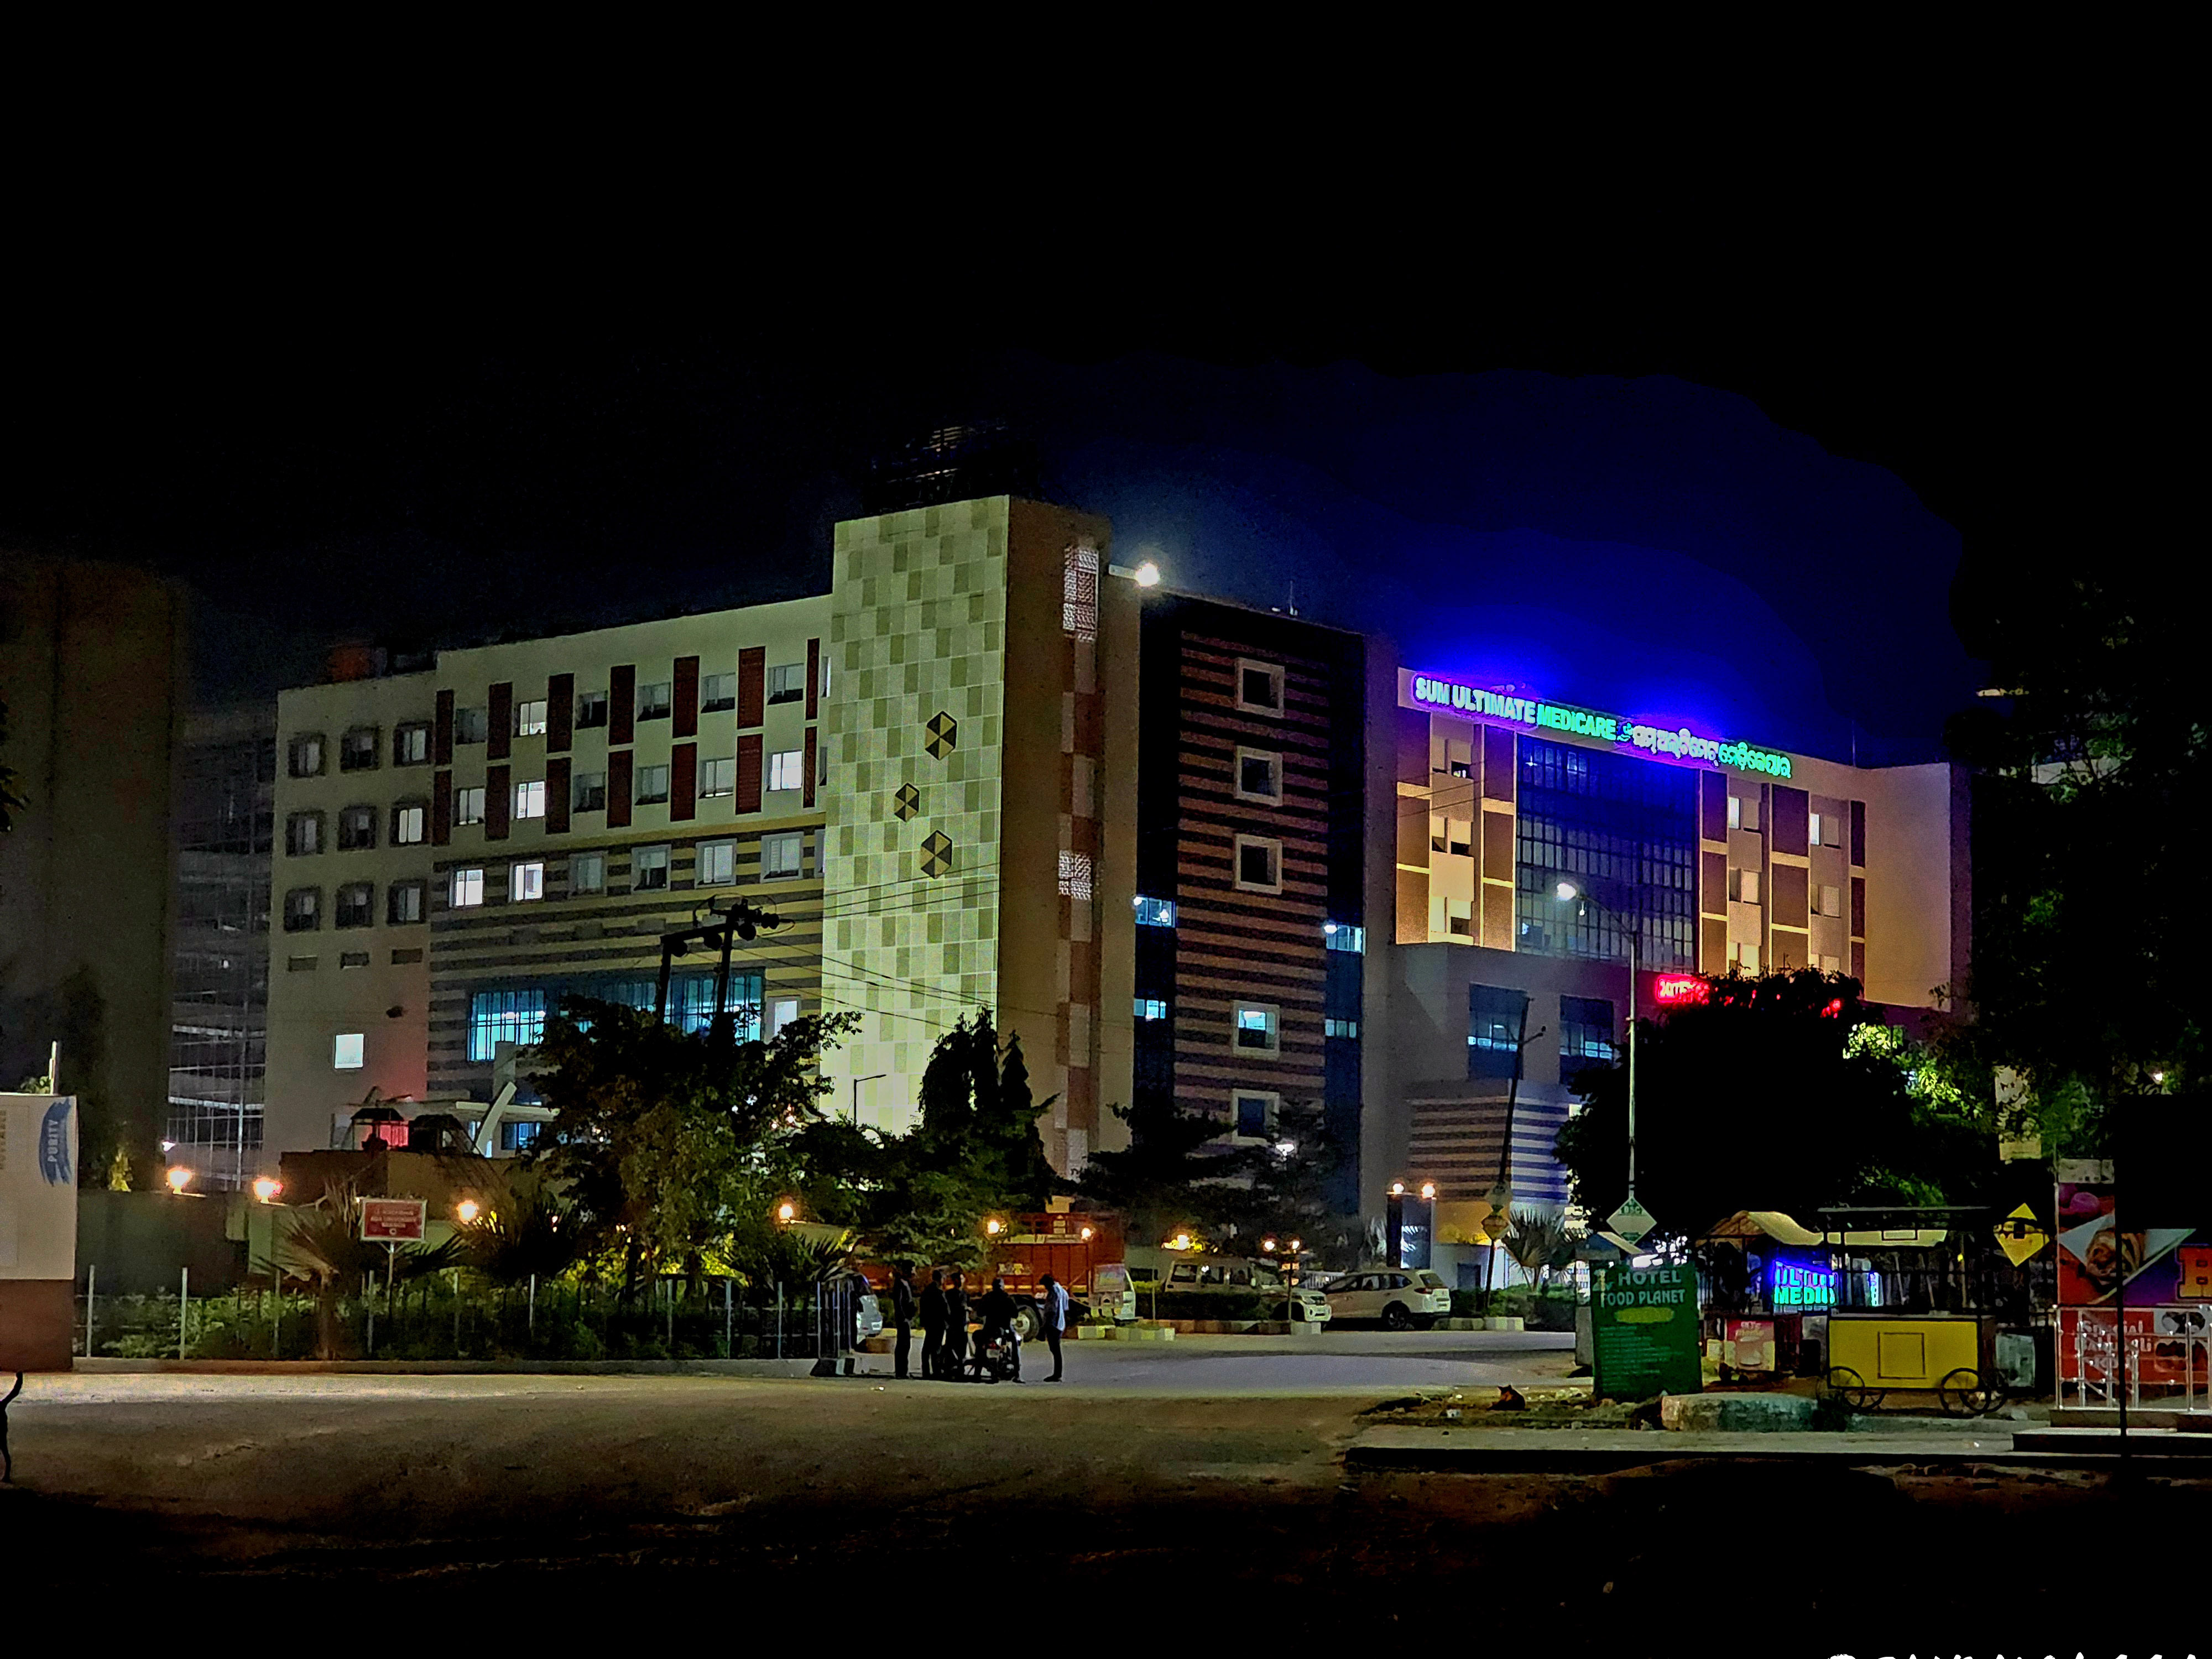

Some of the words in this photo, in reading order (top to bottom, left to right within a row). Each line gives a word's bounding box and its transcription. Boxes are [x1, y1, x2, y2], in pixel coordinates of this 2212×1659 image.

[1415, 677, 1450, 706] SUM
[1452, 684, 1536, 724] ULTIMATE
[47, 1119, 59, 1162] PURITY
[1618, 1270, 1682, 1286] HOTEL
[1639, 1289, 1686, 1305] PLANET
